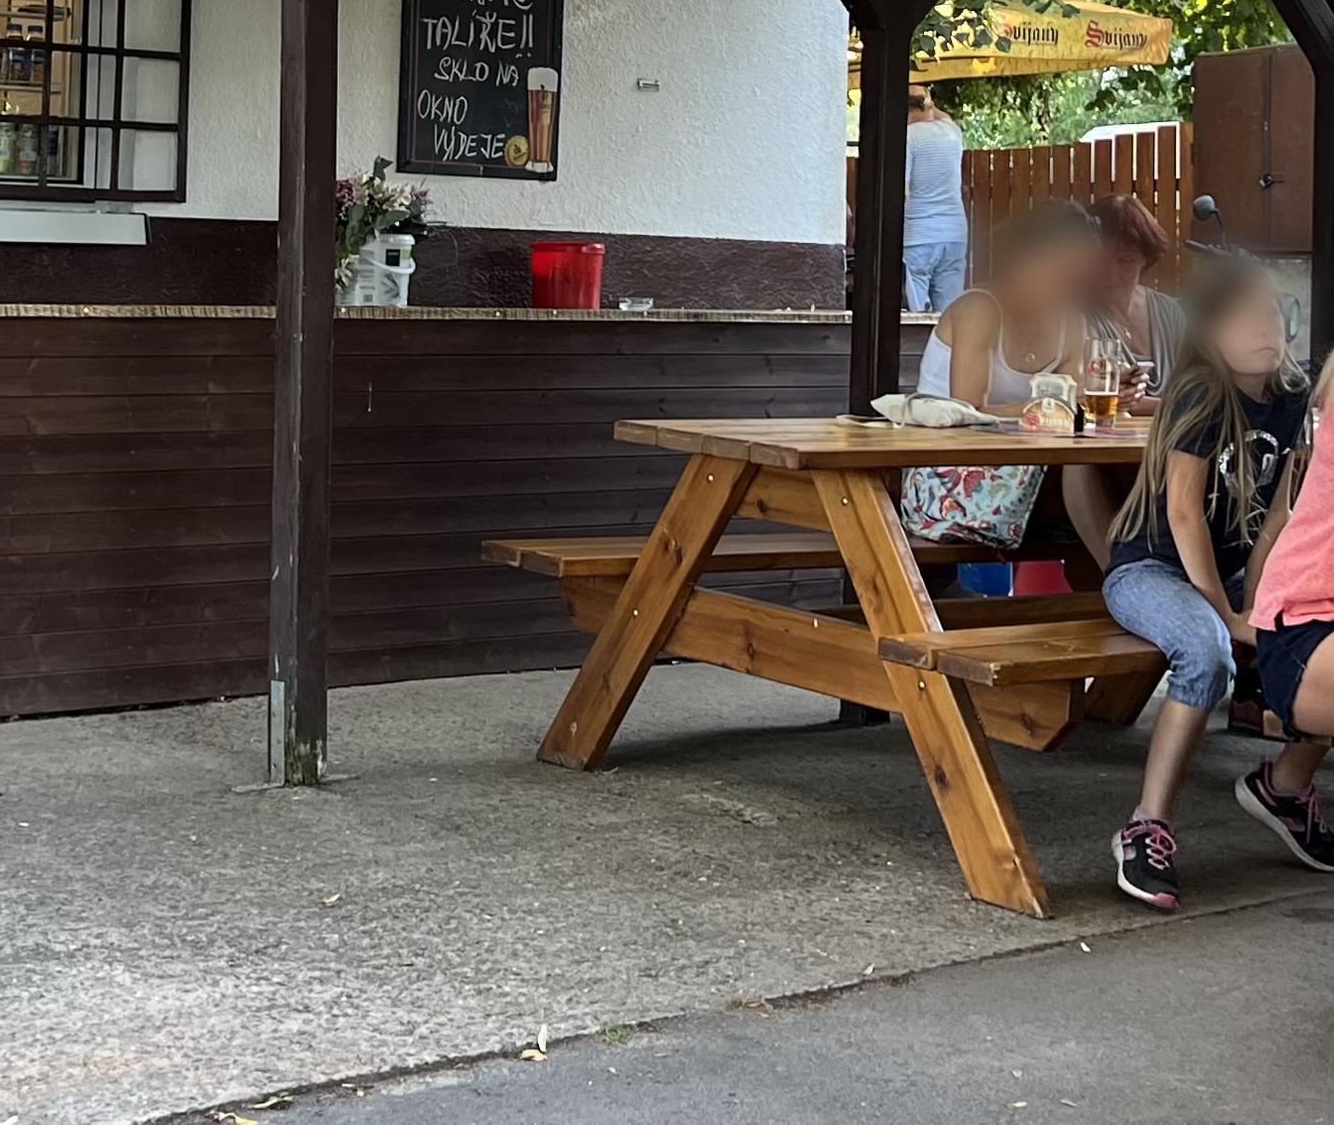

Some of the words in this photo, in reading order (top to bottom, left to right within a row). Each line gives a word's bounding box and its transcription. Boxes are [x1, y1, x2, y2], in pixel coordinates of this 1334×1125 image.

[1084, 19, 1148, 51] Svijany
[433, 55, 489, 82] SKLO
[495, 61, 519, 87] NA
[417, 89, 468, 125] OKNO
[433, 124, 506, 162] VÝDEJE
